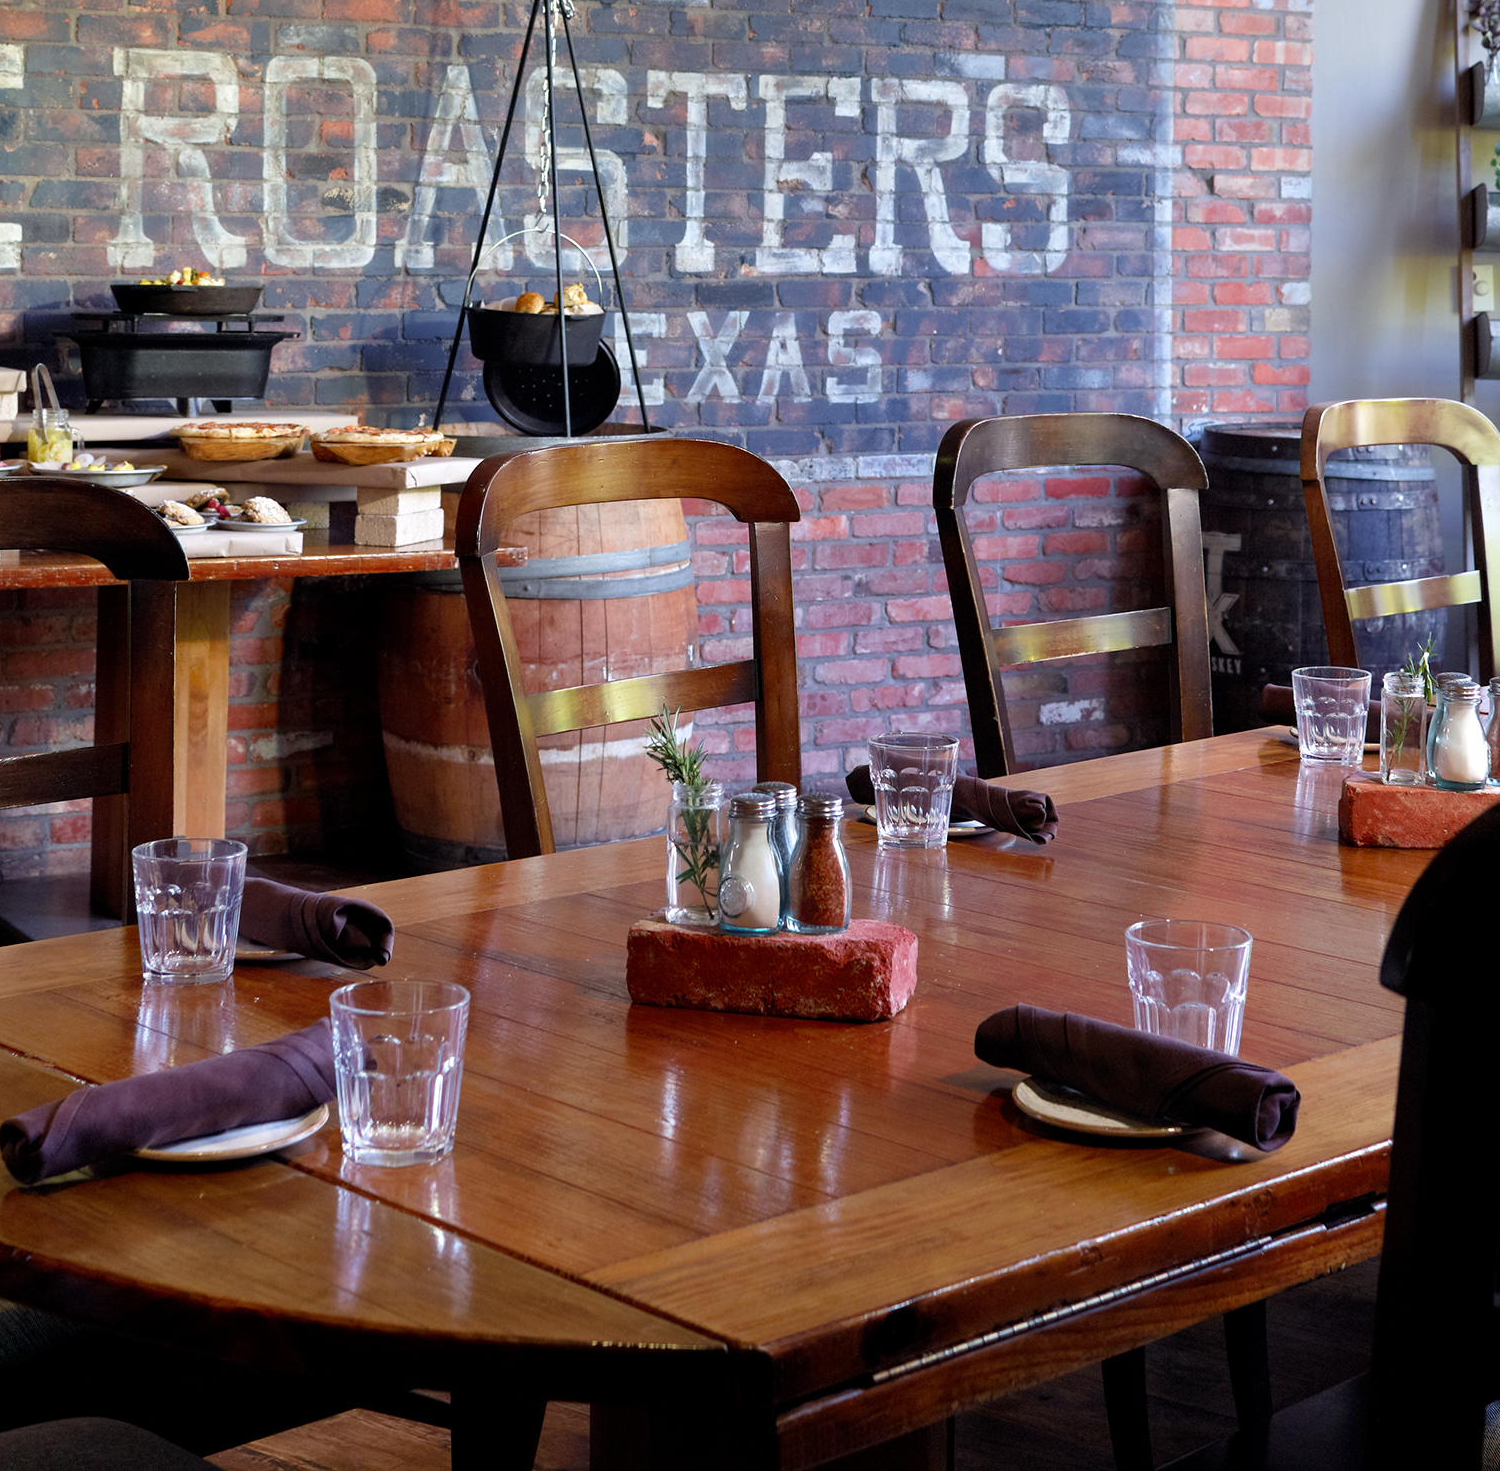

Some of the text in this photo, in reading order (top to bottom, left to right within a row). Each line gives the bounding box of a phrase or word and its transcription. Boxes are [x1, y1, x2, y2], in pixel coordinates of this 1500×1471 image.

[105, 47, 1071, 277] ROASTERS
[613, 310, 882, 406] EXAS
[1211, 656, 1242, 675] SKEY
